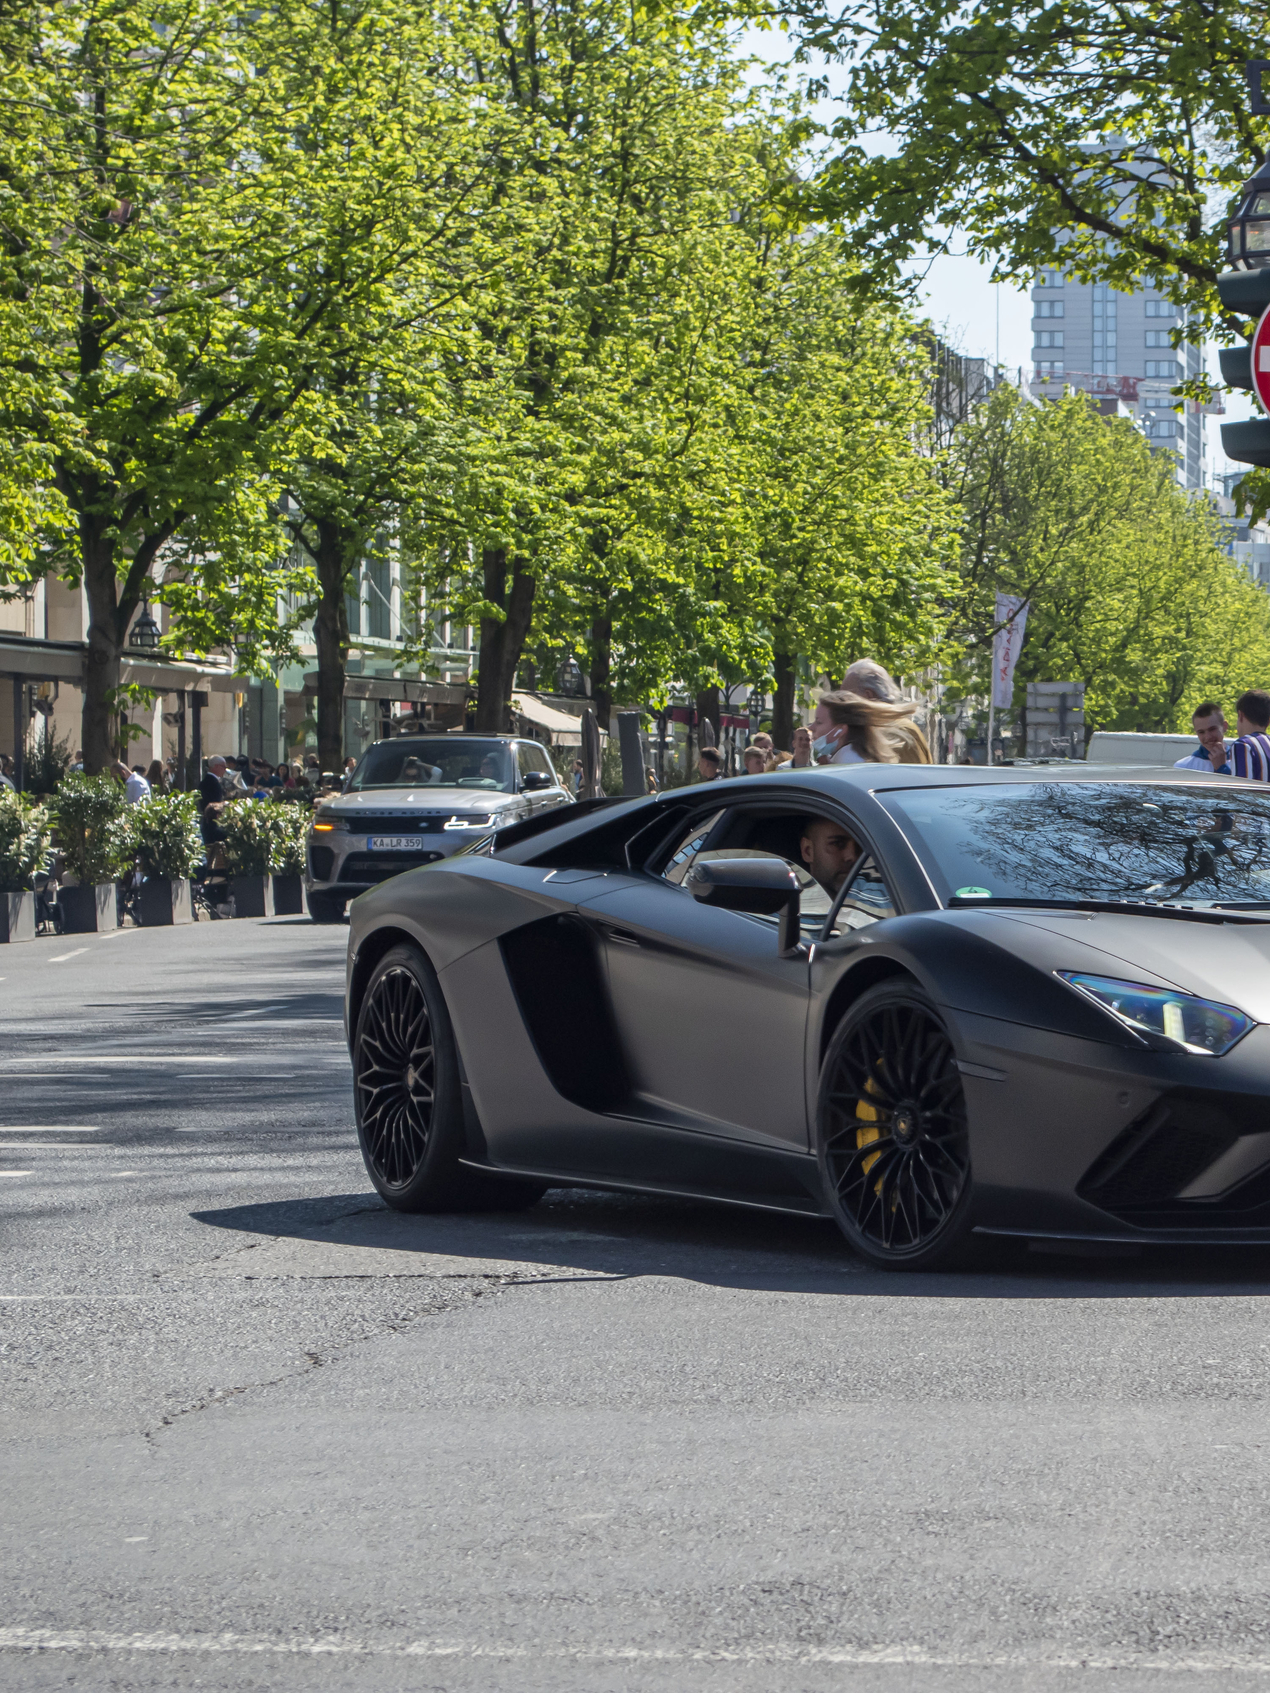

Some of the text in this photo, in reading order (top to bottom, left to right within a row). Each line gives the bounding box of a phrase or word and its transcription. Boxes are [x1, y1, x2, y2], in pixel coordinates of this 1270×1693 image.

[373, 838, 421, 848] KA LR 359
